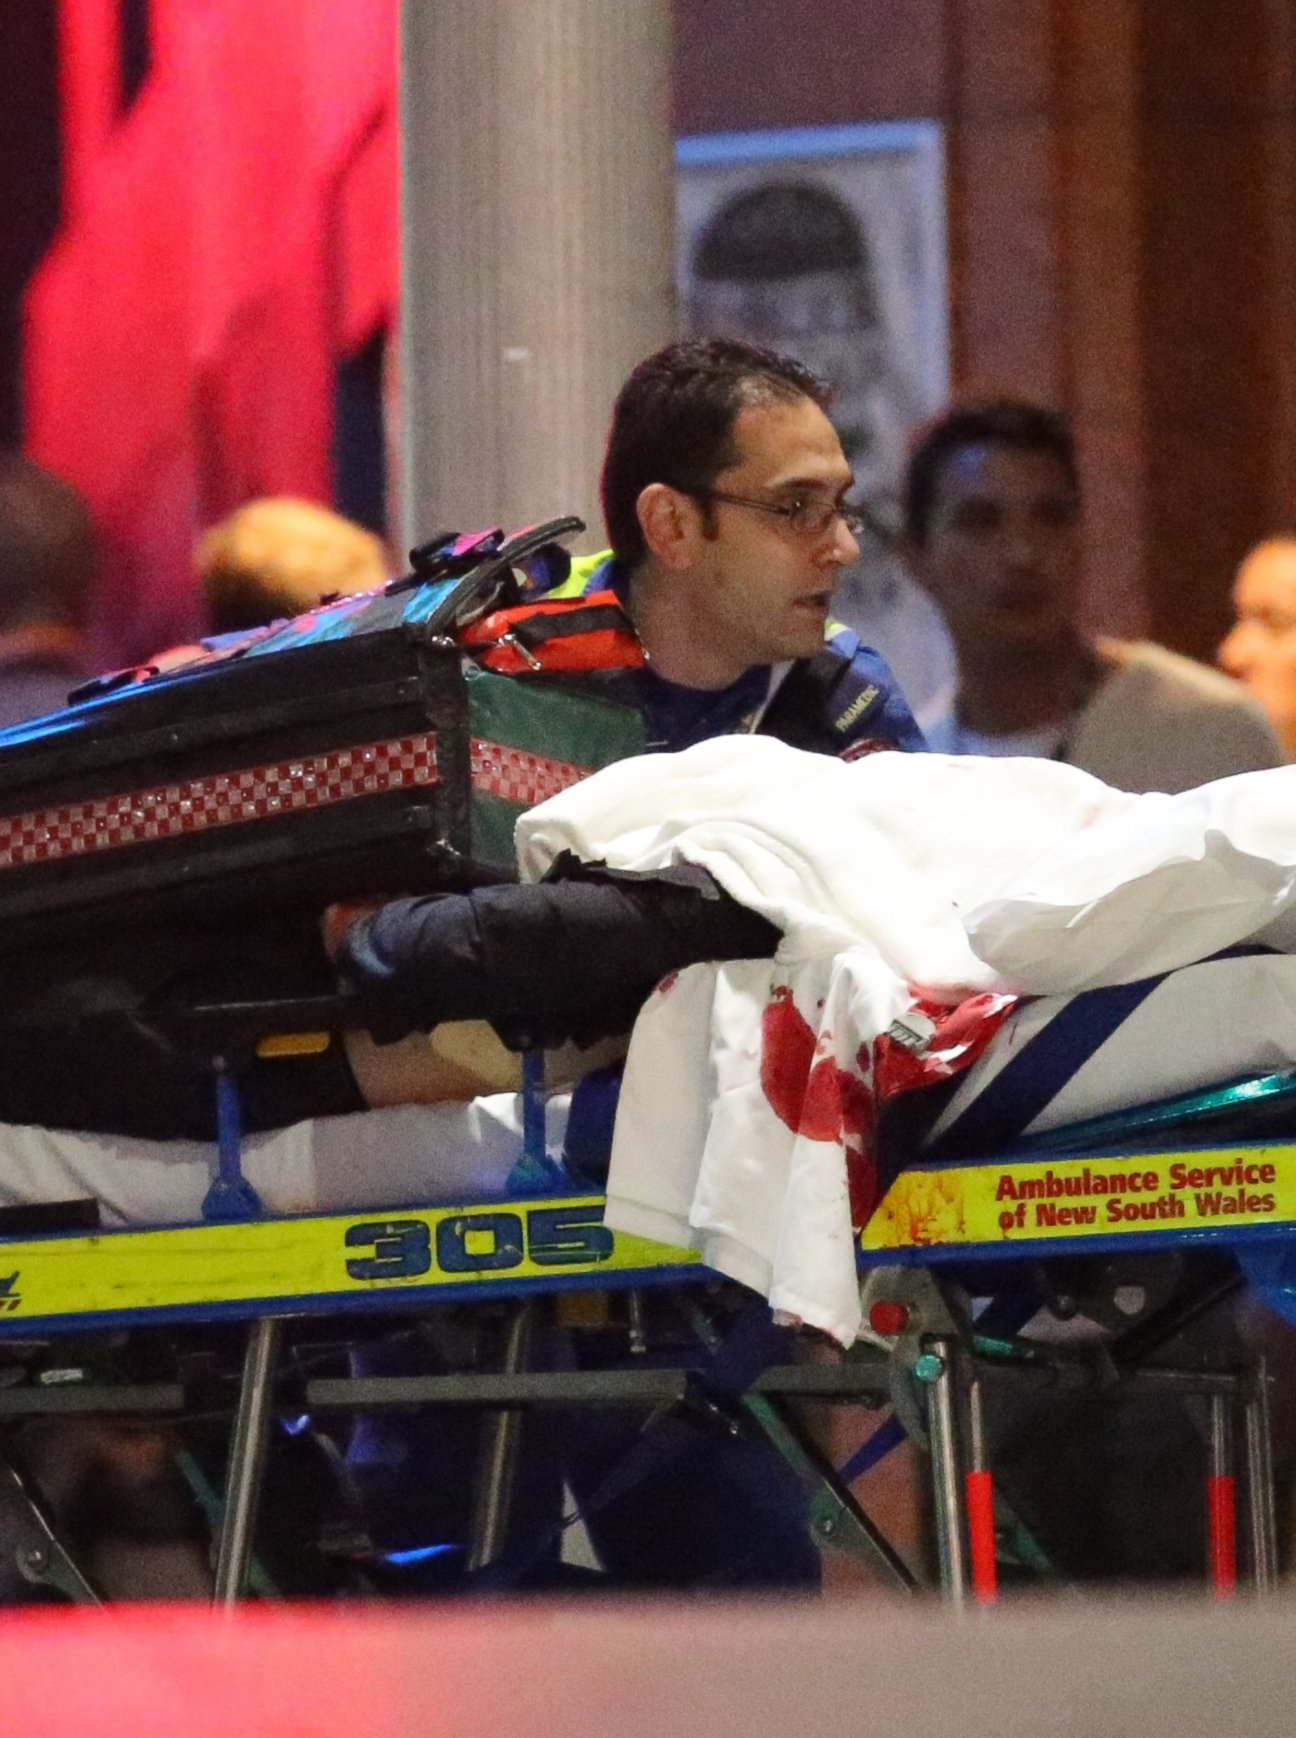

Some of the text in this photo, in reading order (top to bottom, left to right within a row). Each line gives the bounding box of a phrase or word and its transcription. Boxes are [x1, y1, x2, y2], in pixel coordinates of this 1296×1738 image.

[995, 1158, 1276, 1201] Ambulance Service
[998, 1189, 1276, 1230] of New South Wales
[345, 1205, 614, 1280] 305
